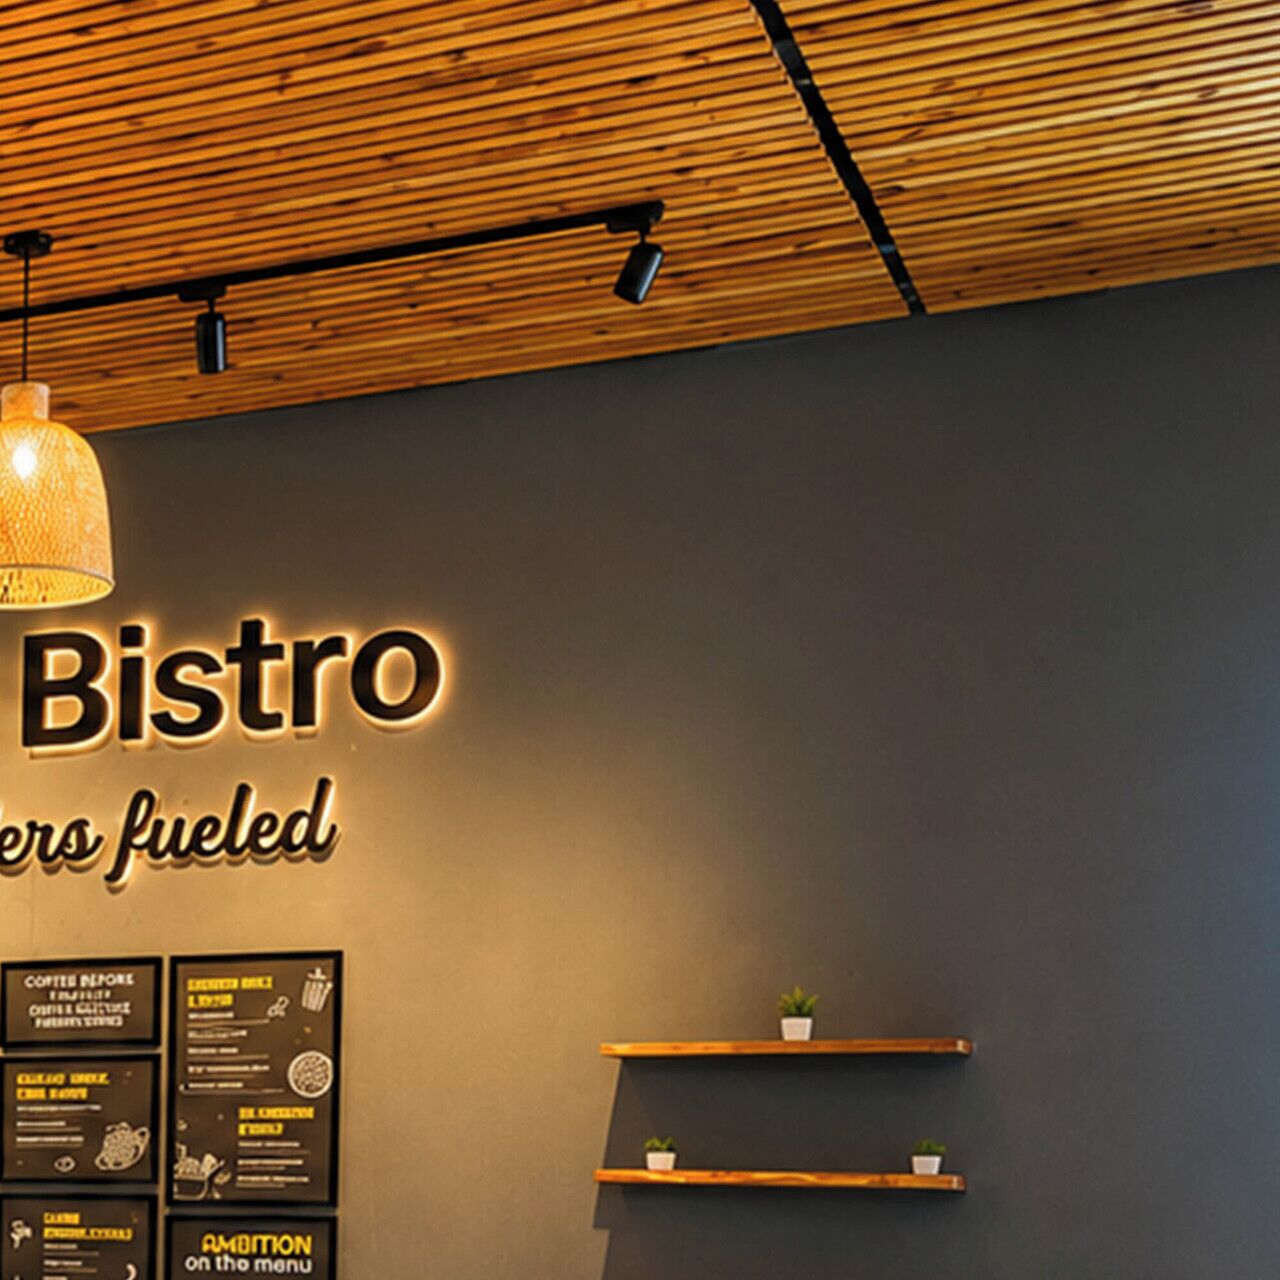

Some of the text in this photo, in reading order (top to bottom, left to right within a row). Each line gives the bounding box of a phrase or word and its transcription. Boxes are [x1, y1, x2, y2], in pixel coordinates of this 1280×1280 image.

[21, 620, 441, 748] Bistro
[104, 776, 338, 884] fueled
[185, 1254, 312, 1273] on the menu
[201, 1234, 312, 1255] AMBITION
